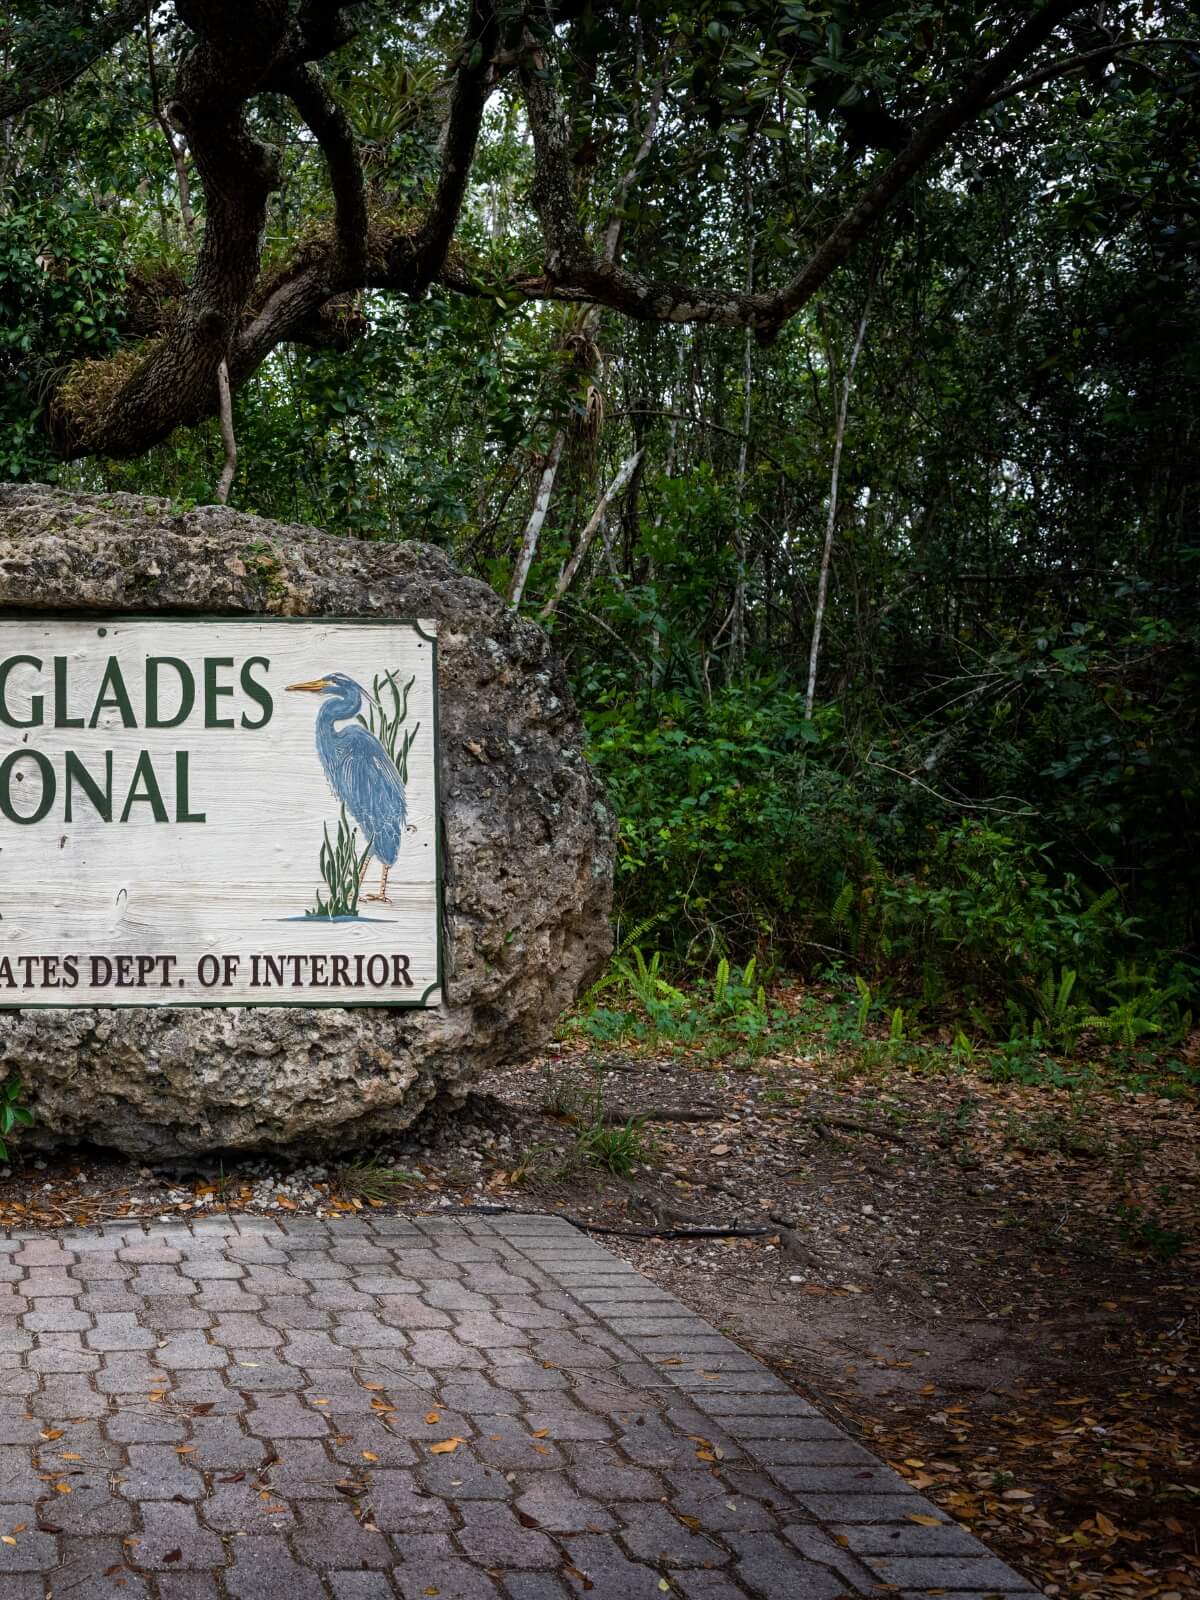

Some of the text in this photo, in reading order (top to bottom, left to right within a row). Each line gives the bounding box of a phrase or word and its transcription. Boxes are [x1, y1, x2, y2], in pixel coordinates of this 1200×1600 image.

[89, 955, 185, 988] DEPT.
[197, 954, 242, 987] OF
[250, 953, 414, 988] INTERIOR
